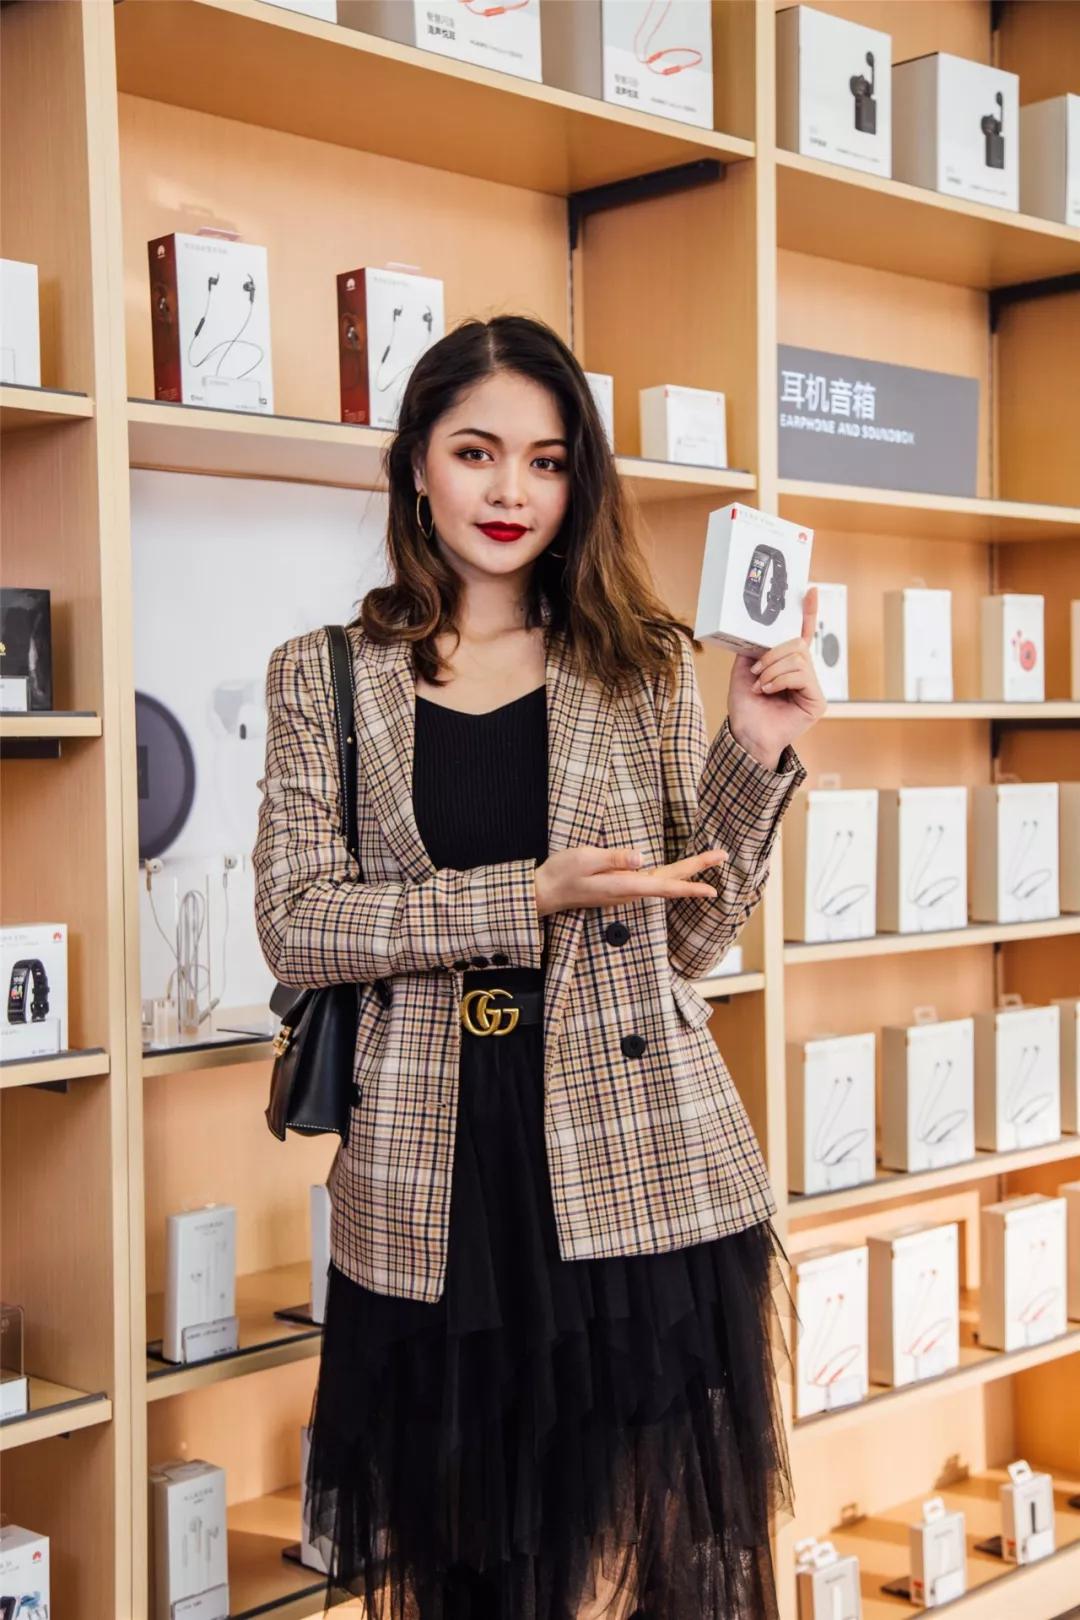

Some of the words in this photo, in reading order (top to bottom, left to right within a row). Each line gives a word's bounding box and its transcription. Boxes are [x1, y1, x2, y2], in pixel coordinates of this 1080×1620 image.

[780, 370, 876, 421] 耳机音箱
[780, 413, 836, 434] EARPHONE
[837, 422, 860, 437] AND
[861, 424, 915, 445] SOUNDBOX
